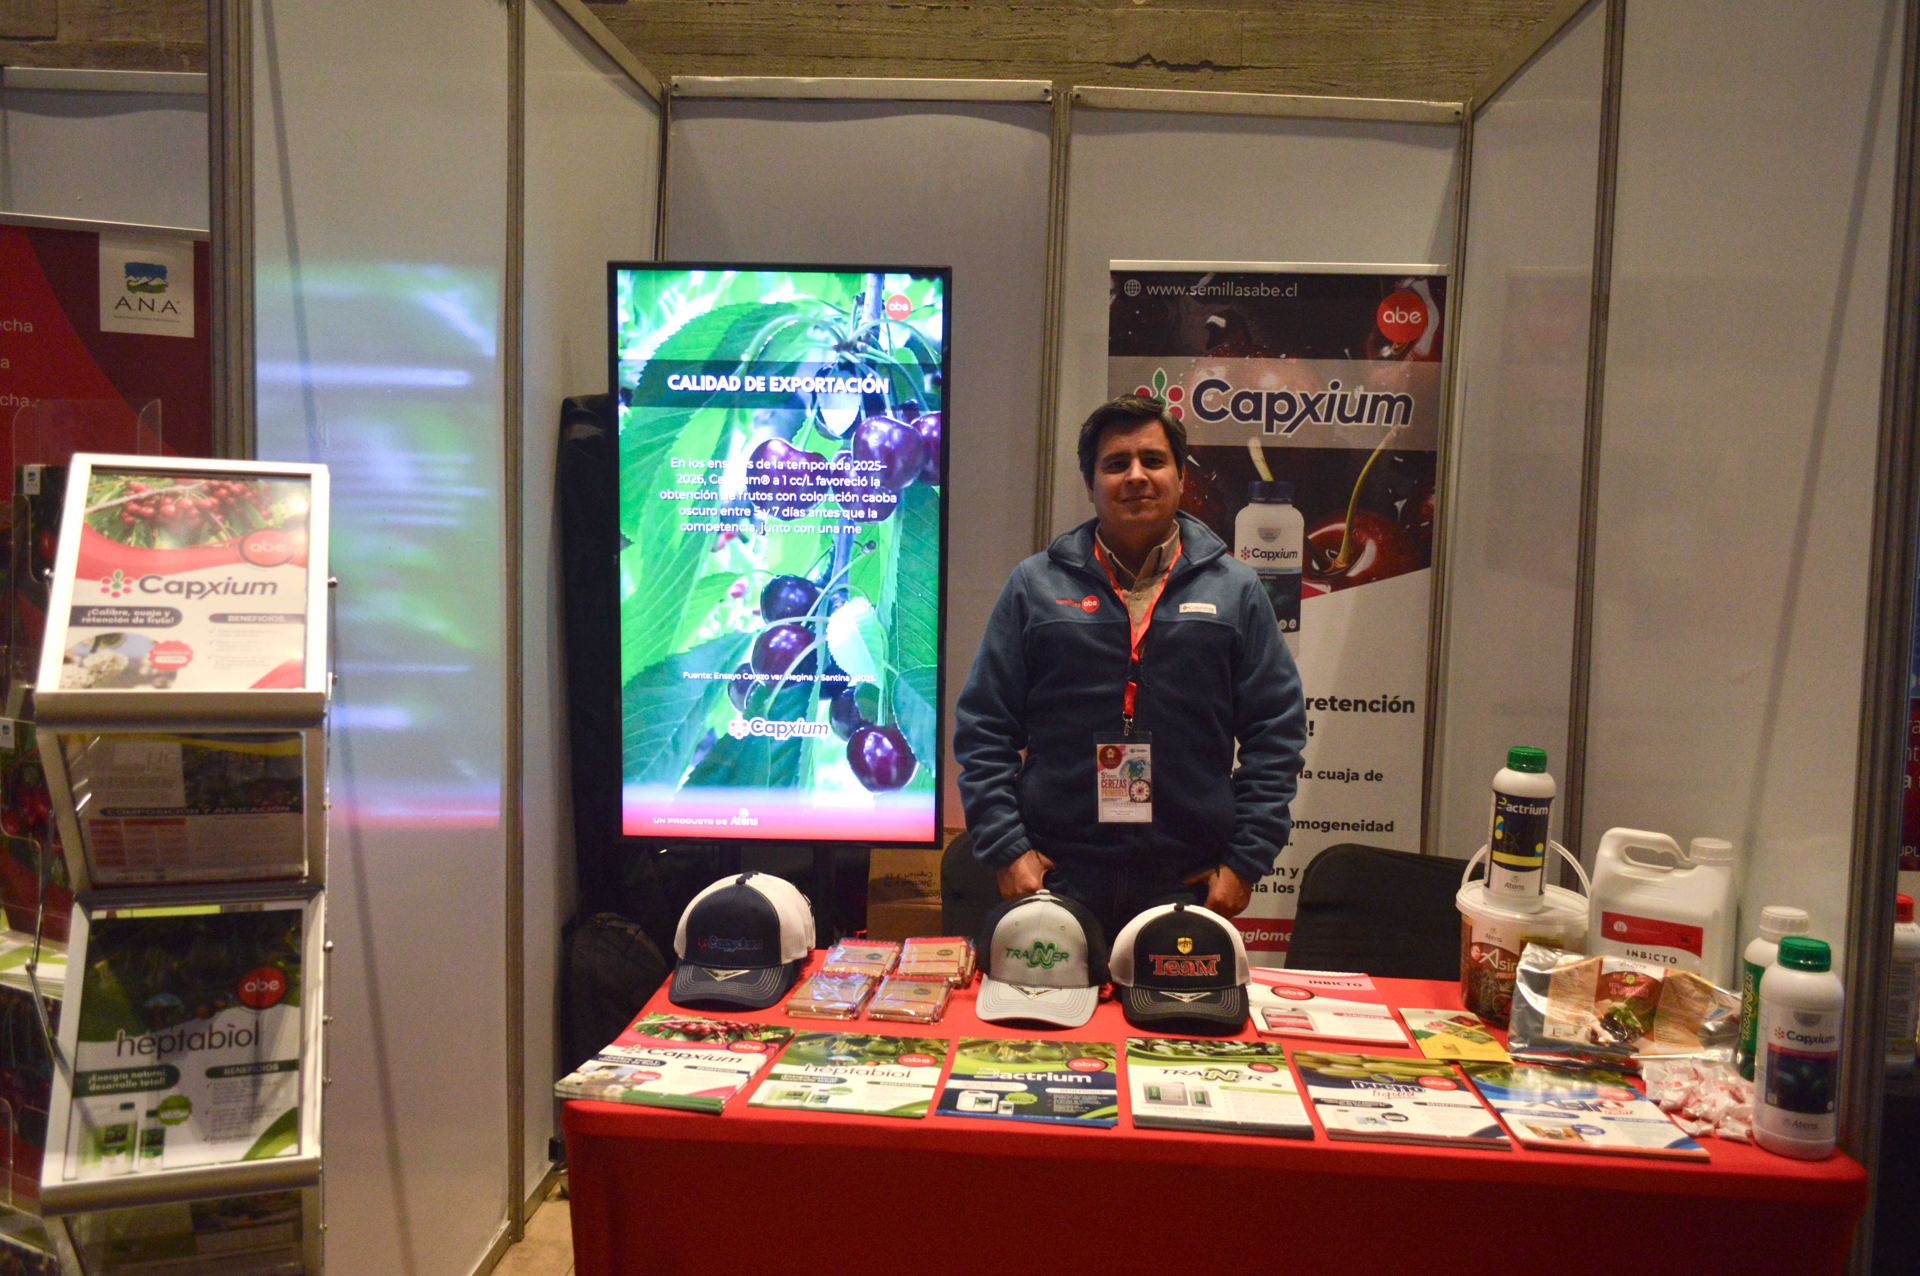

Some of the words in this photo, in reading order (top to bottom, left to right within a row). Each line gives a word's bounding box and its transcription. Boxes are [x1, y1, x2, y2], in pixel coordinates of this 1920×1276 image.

[1146, 282, 1298, 297] www.semillasabe.cl
[1383, 306, 1422, 324] abe
[667, 374, 741, 391] CALIDAD
[744, 376, 766, 392] DE
[769, 373, 889, 394] EXPORTACIÓN
[1192, 378, 1413, 435] Capxium
[671, 457, 685, 468] En
[689, 458, 705, 468] los
[708, 459, 754, 469] enss
[756, 459, 770, 469] de
[773, 459, 784, 470] la
[787, 460, 851, 472] temporada
[676, 473, 707, 486] 2026,
[773, 477, 780, 485] a
[782, 475, 787, 486] 1
[789, 475, 813, 487] cc/L
[816, 475, 868, 487] favoreció
[870, 476, 880, 487] la
[660, 489, 718, 500] obtención
[775, 492, 797, 501] con
[800, 491, 859, 502] coloración
[862, 493, 897, 503] caoba
[679, 507, 718, 516] oscuro
[720, 507, 751, 517] entre
[772, 507, 780, 517] 7
[782, 506, 806, 517] días
[809, 508, 840, 518] antes
[842, 509, 865, 520] que
[867, 508, 878, 518] la
[760, 522, 790, 534] junto
[794, 524, 815, 533] con
[818, 524, 840, 534] una
[843, 525, 862, 534] me
[1252, 547, 1298, 561] Capxium
[139, 574, 278, 600] Capxium
[81, 616, 129, 624] retención
[134, 616, 145, 624] de
[714, 672, 741, 681] Ensayo
[821, 674, 850, 682] Santina
[1305, 694, 1415, 713] retención
[751, 719, 829, 738] Capxium
[1317, 768, 1359, 783] cuaja
[1364, 770, 1384, 781] de
[1289, 867, 1299, 879] y
[1273, 882, 1295, 893] los
[1626, 949, 1677, 964] INBICTO
[245, 977, 280, 993] abe
[1786, 1030, 1836, 1046] Capxium
[648, 1047, 743, 1064] Capxium
